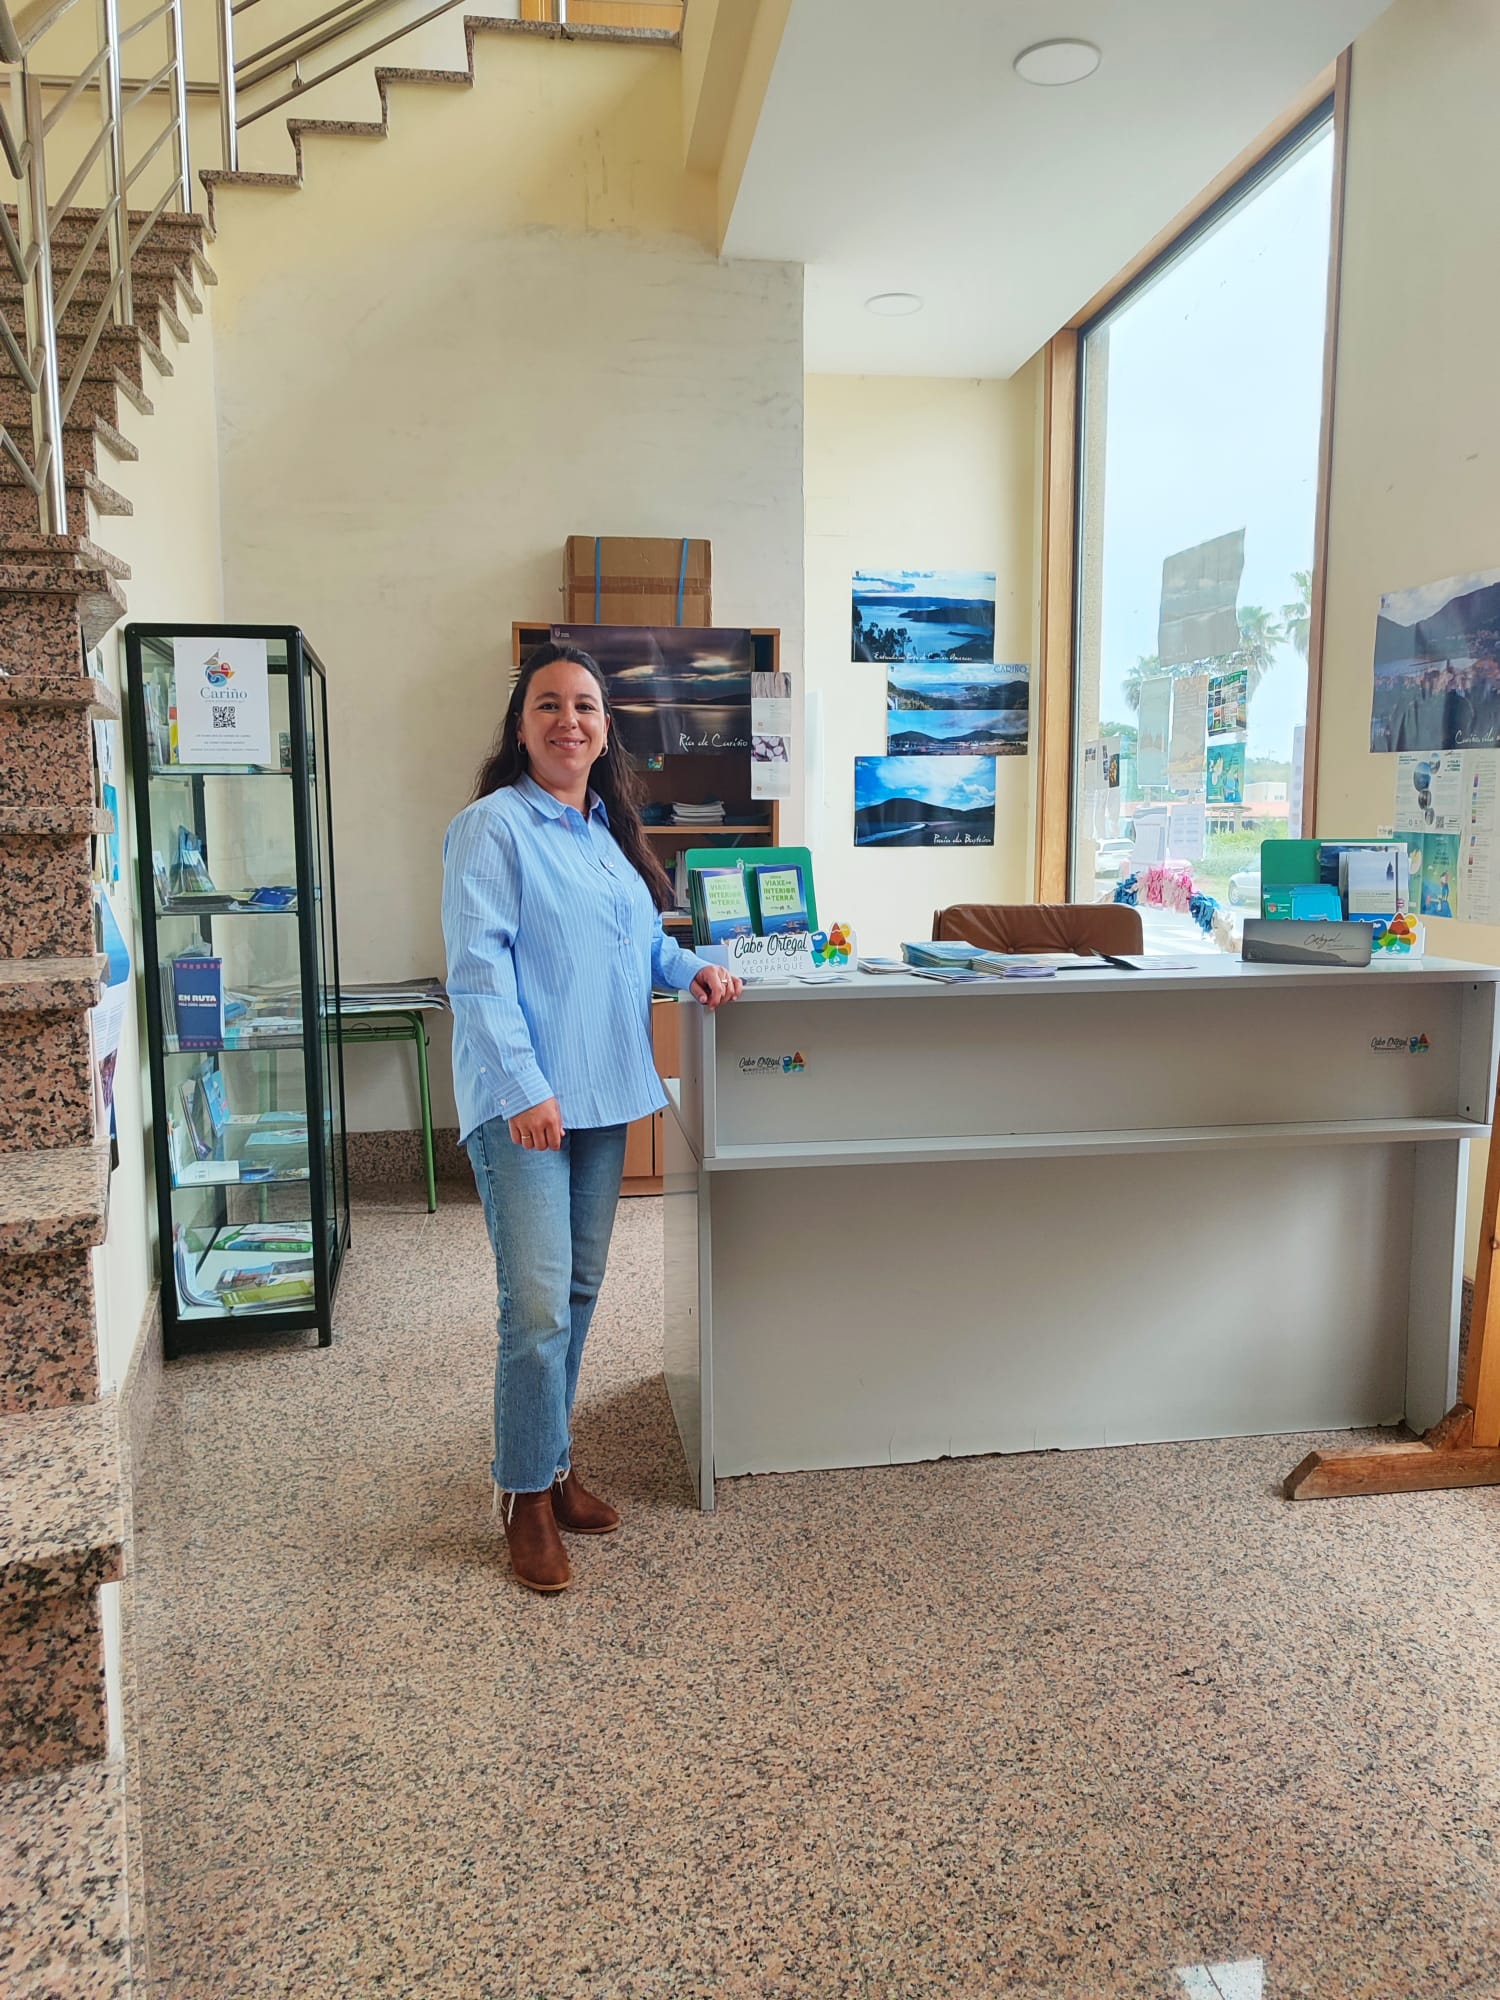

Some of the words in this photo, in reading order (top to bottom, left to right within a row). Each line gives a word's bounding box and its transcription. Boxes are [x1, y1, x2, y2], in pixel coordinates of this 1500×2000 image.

[993, 664, 1027, 673] CARIÑO
[200, 687, 248, 700] Cariño
[679, 733, 695, 752] Ría
[697, 730, 709, 746] de
[711, 733, 748, 748] Cariño
[933, 833, 951, 845] Praia
[952, 832, 962, 843] da
[734, 936, 763, 958] Cabo
[766, 932, 808, 956] Ortegal
[741, 957, 787, 966] PROXECTO
[742, 963, 804, 974] XEOPARQUE
[738, 1056, 755, 1068] Cabo
[757, 1055, 781, 1068] Ortegal
